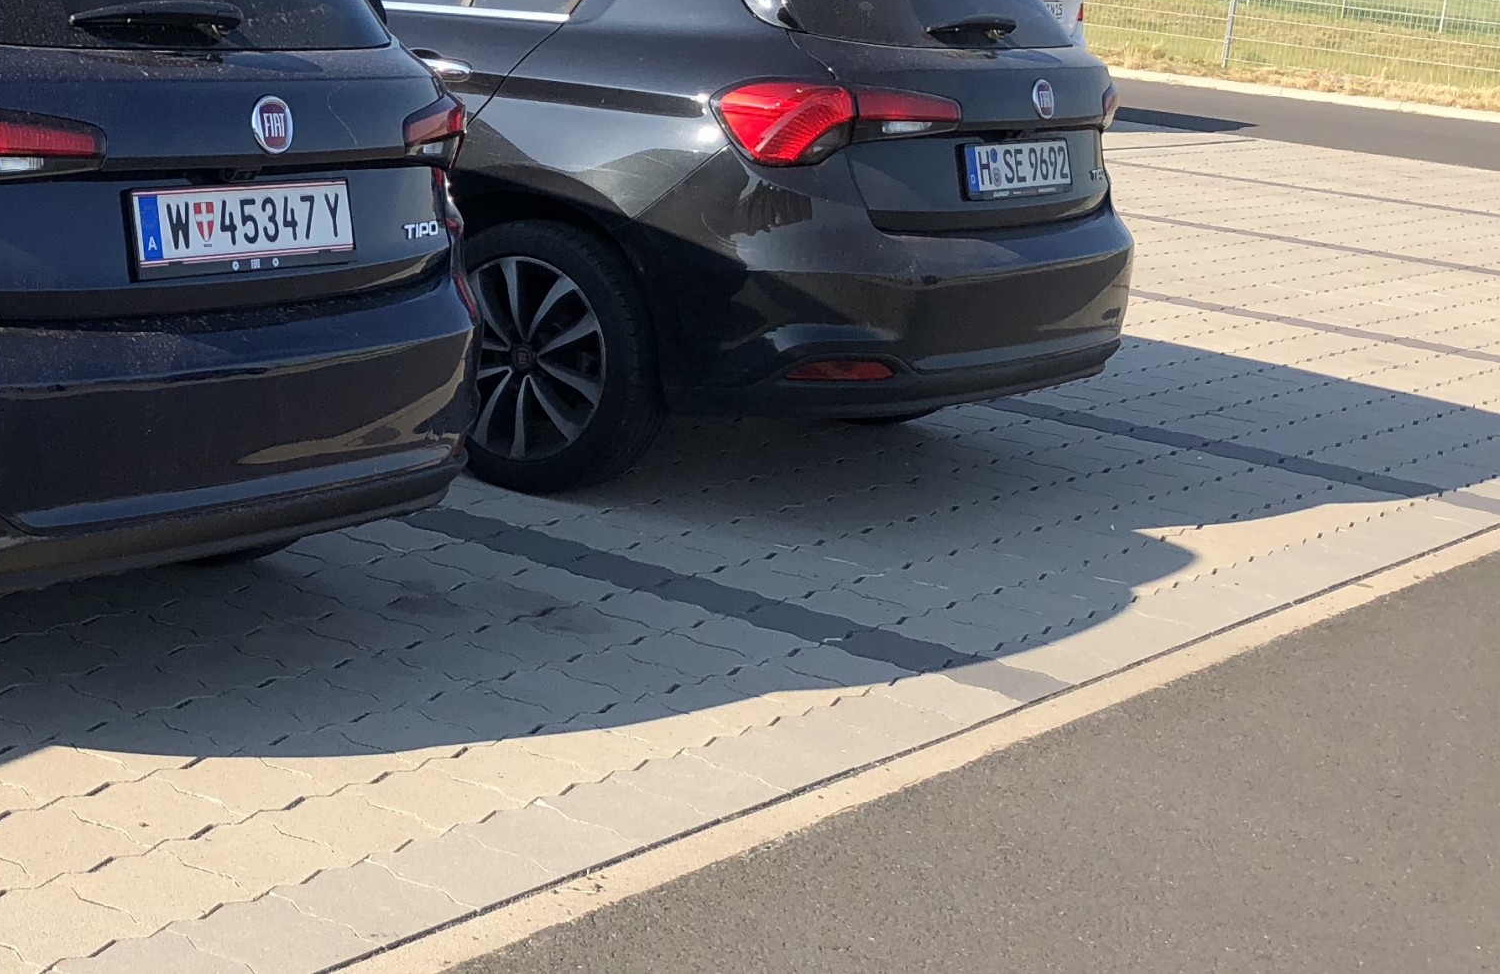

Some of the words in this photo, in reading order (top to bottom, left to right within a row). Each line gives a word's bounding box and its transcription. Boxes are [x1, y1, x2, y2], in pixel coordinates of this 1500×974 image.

[263, 113, 285, 137] FIAT
[978, 150, 992, 186] H
[1003, 149, 1027, 184] SE
[1028, 146, 1069, 181] 9692
[148, 236, 158, 251] A
[166, 201, 190, 250] W
[220, 195, 315, 246] 45347
[324, 193, 339, 238] Y
[404, 220, 438, 239] TIPO
